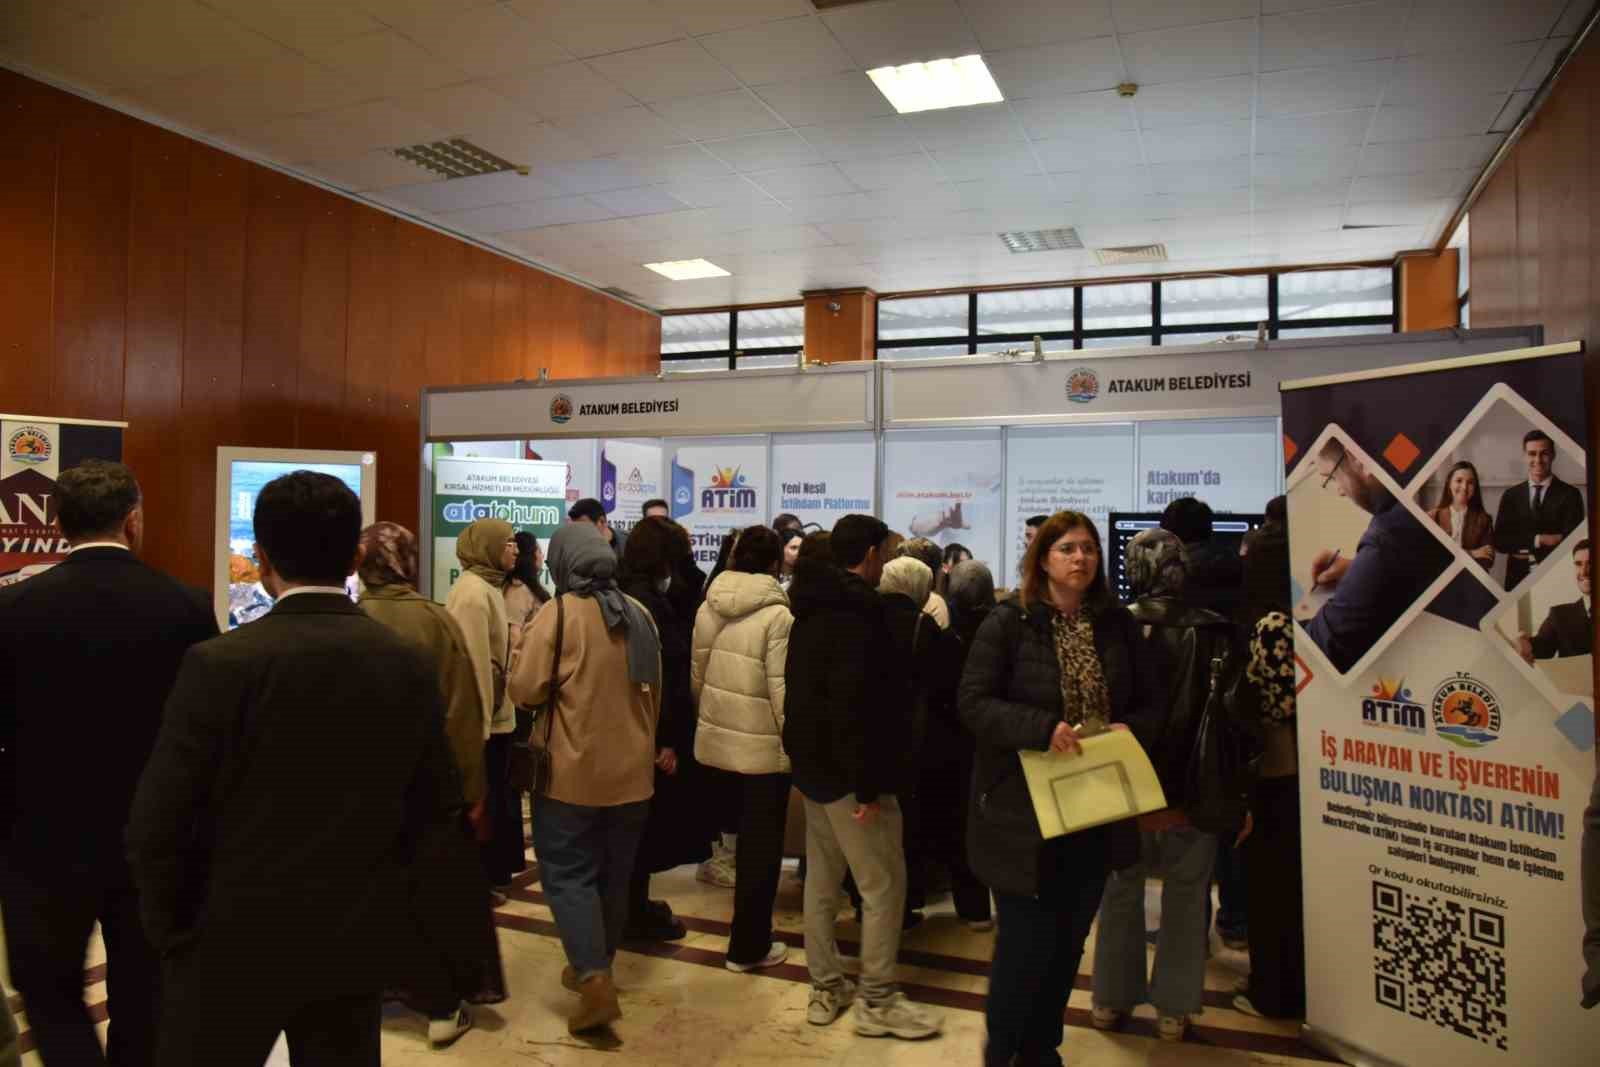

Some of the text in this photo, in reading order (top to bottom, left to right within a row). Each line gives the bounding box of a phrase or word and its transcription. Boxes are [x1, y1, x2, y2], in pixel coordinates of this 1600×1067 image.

[1108, 377, 1165, 393] ATAKUM
[1169, 371, 1251, 390] BELEDİYESİ
[579, 403, 619, 416] ATAKUM
[621, 398, 679, 414] BELEDİYESİ
[1146, 469, 1221, 486] Atakum'da
[782, 482, 826, 495] Yeni Nesil
[1146, 487, 1197, 505] kariyer
[691, 550, 719, 562] MER
[1456, 671, 1472, 680] T.C.
[1321, 730, 1560, 800] İŞ ARAYAN VE İŞVERENİN
[1320, 767, 1565, 839] BULUŞMA NOKTASI ATİM!
[1430, 824, 1466, 843] kurulan
[1468, 833, 1508, 851] Atakum
[1509, 839, 1557, 862] İstihdam
[1401, 833, 1421, 847] hem
[1423, 837, 1432, 852] iş
[1434, 842, 1480, 861] arayanlar
[1481, 851, 1505, 867] hem
[1507, 858, 1521, 871] de
[1523, 861, 1565, 881] işletme
[1368, 864, 1509, 909] Qr kodu okutabilirsiniz.
